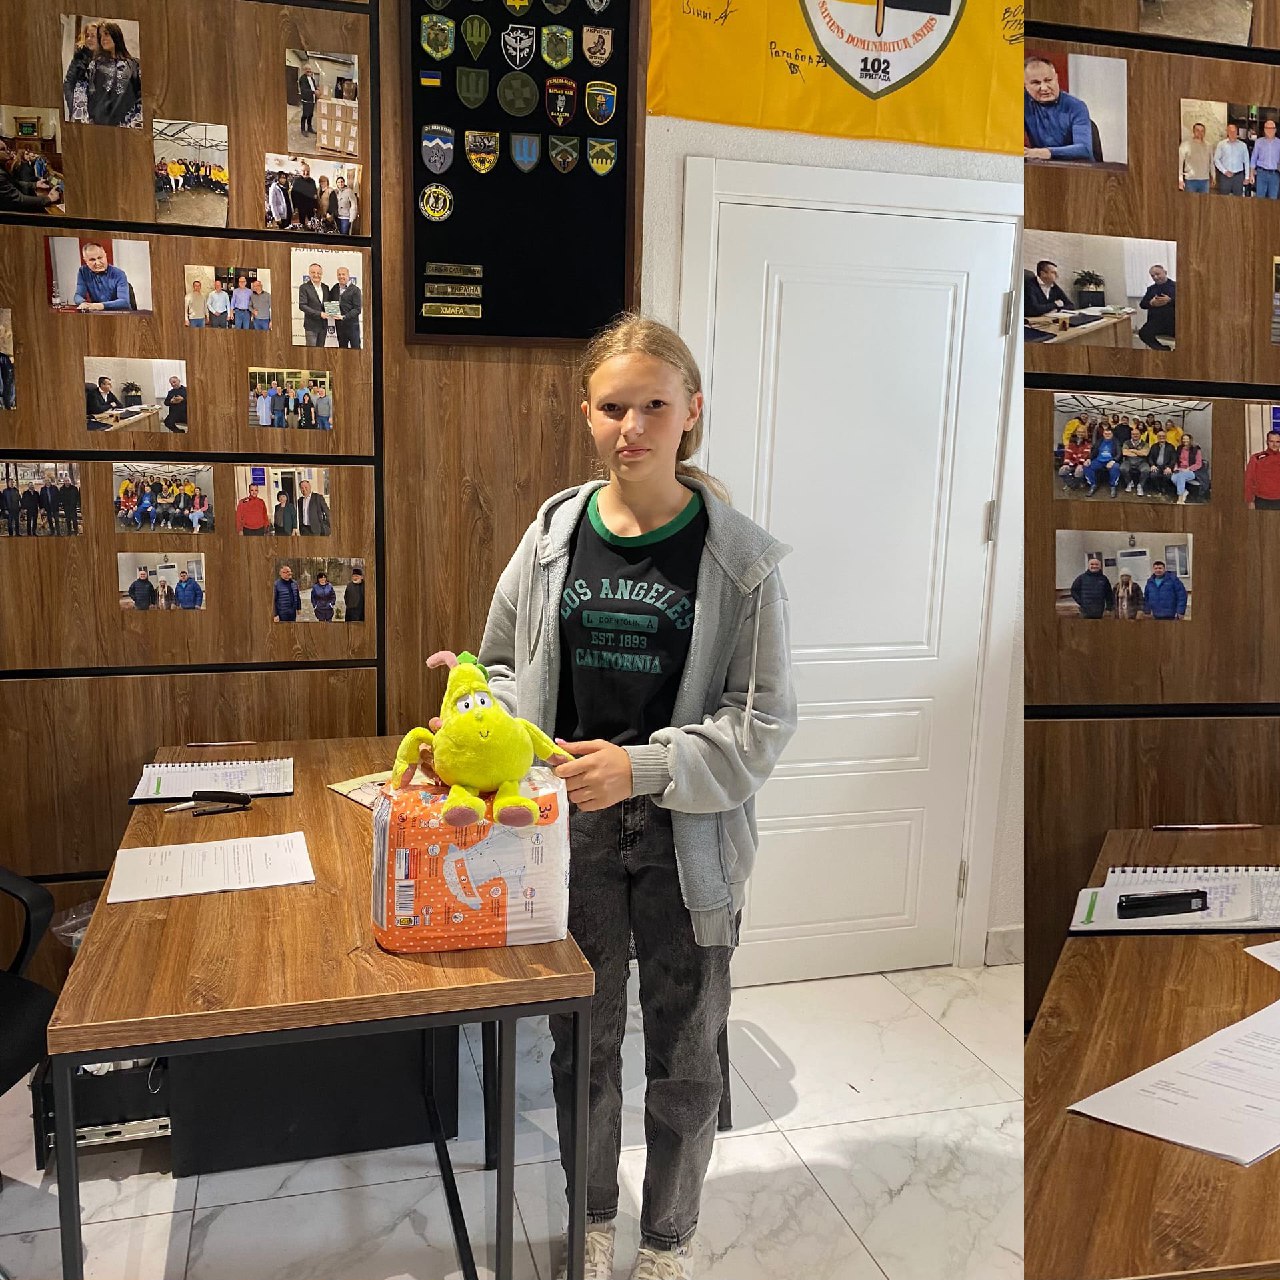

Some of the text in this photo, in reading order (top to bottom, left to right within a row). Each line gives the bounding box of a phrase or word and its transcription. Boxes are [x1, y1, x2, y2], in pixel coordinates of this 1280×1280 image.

[818, 0, 846, 39] SAPIENS
[845, 33, 913, 52] DOMINABITUR
[860, 57, 891, 75] 102
[859, 72, 891, 82] БРИГАДА
[440, 306, 465, 315] ХМАРА
[600, 578, 694, 630] ANGELES
[591, 631, 648, 649] EST. 1893
[575, 648, 663, 674] CALIFORNIA
